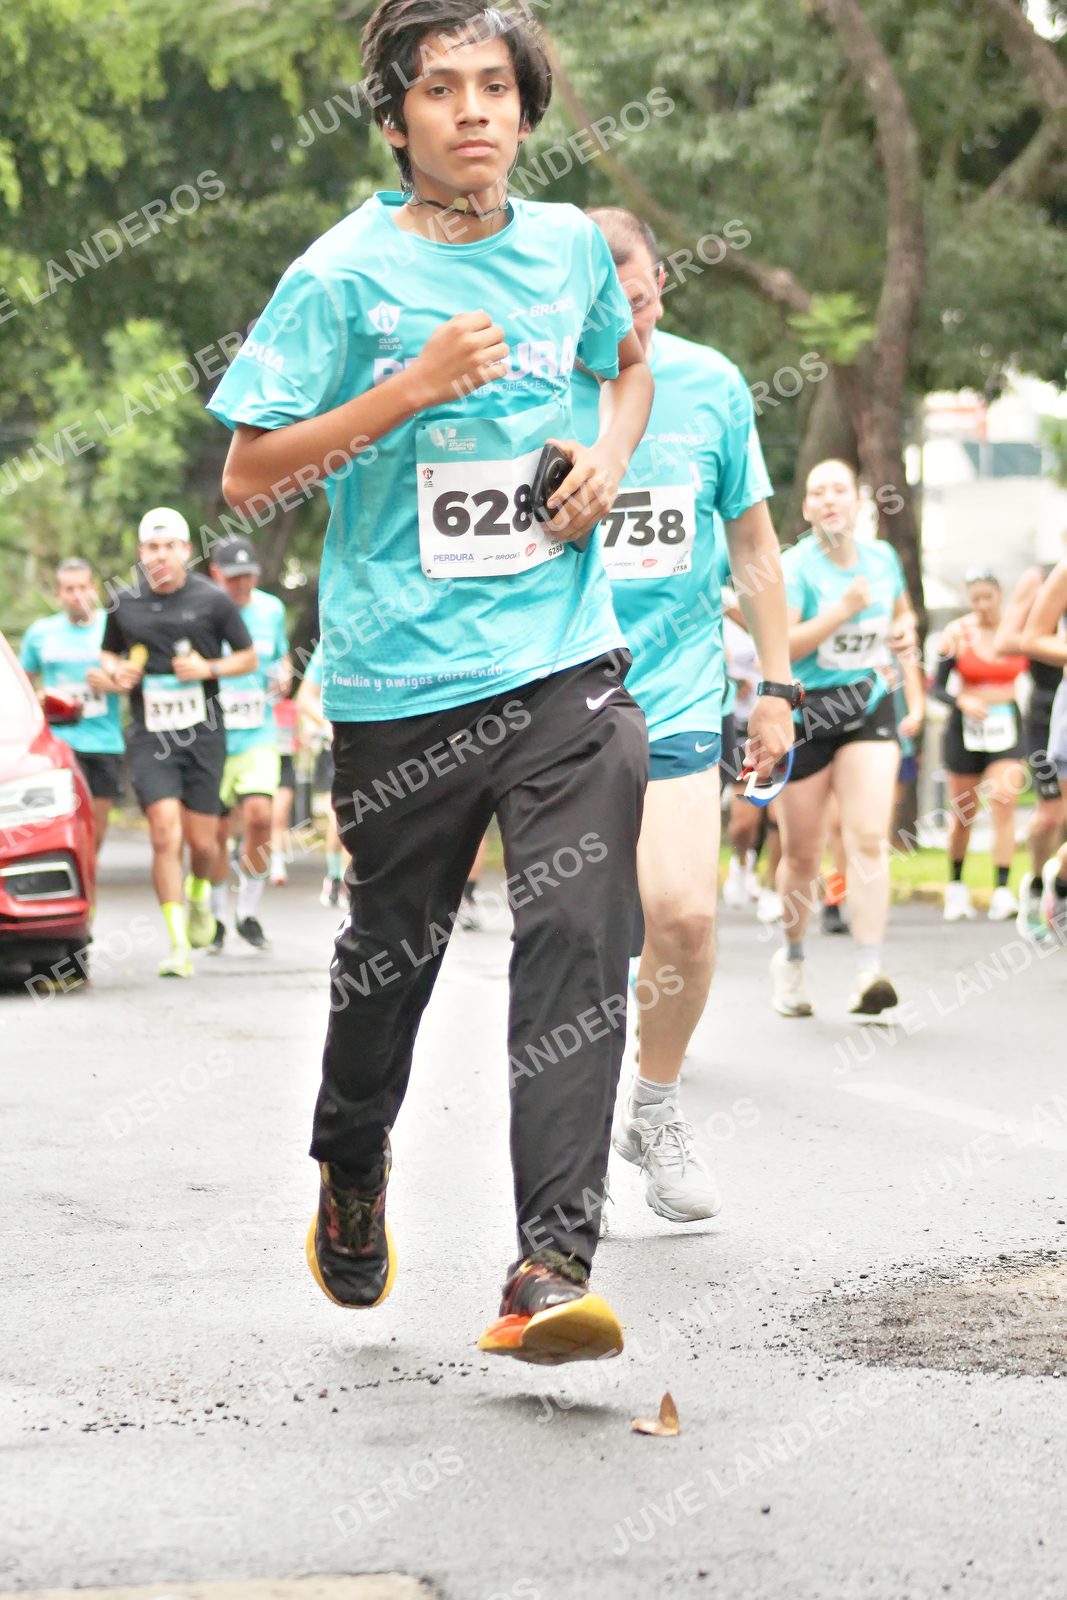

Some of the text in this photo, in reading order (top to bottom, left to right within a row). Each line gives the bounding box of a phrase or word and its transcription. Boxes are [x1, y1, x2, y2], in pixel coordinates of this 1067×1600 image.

[433, 484, 532, 537] 628
[600, 509, 686, 548] 738
[433, 553, 475, 562] PERDURA
[495, 552, 520, 561] BROOKS
[833, 632, 877, 653] 527
[332, 663, 503, 692] familia y amigos corriendo
